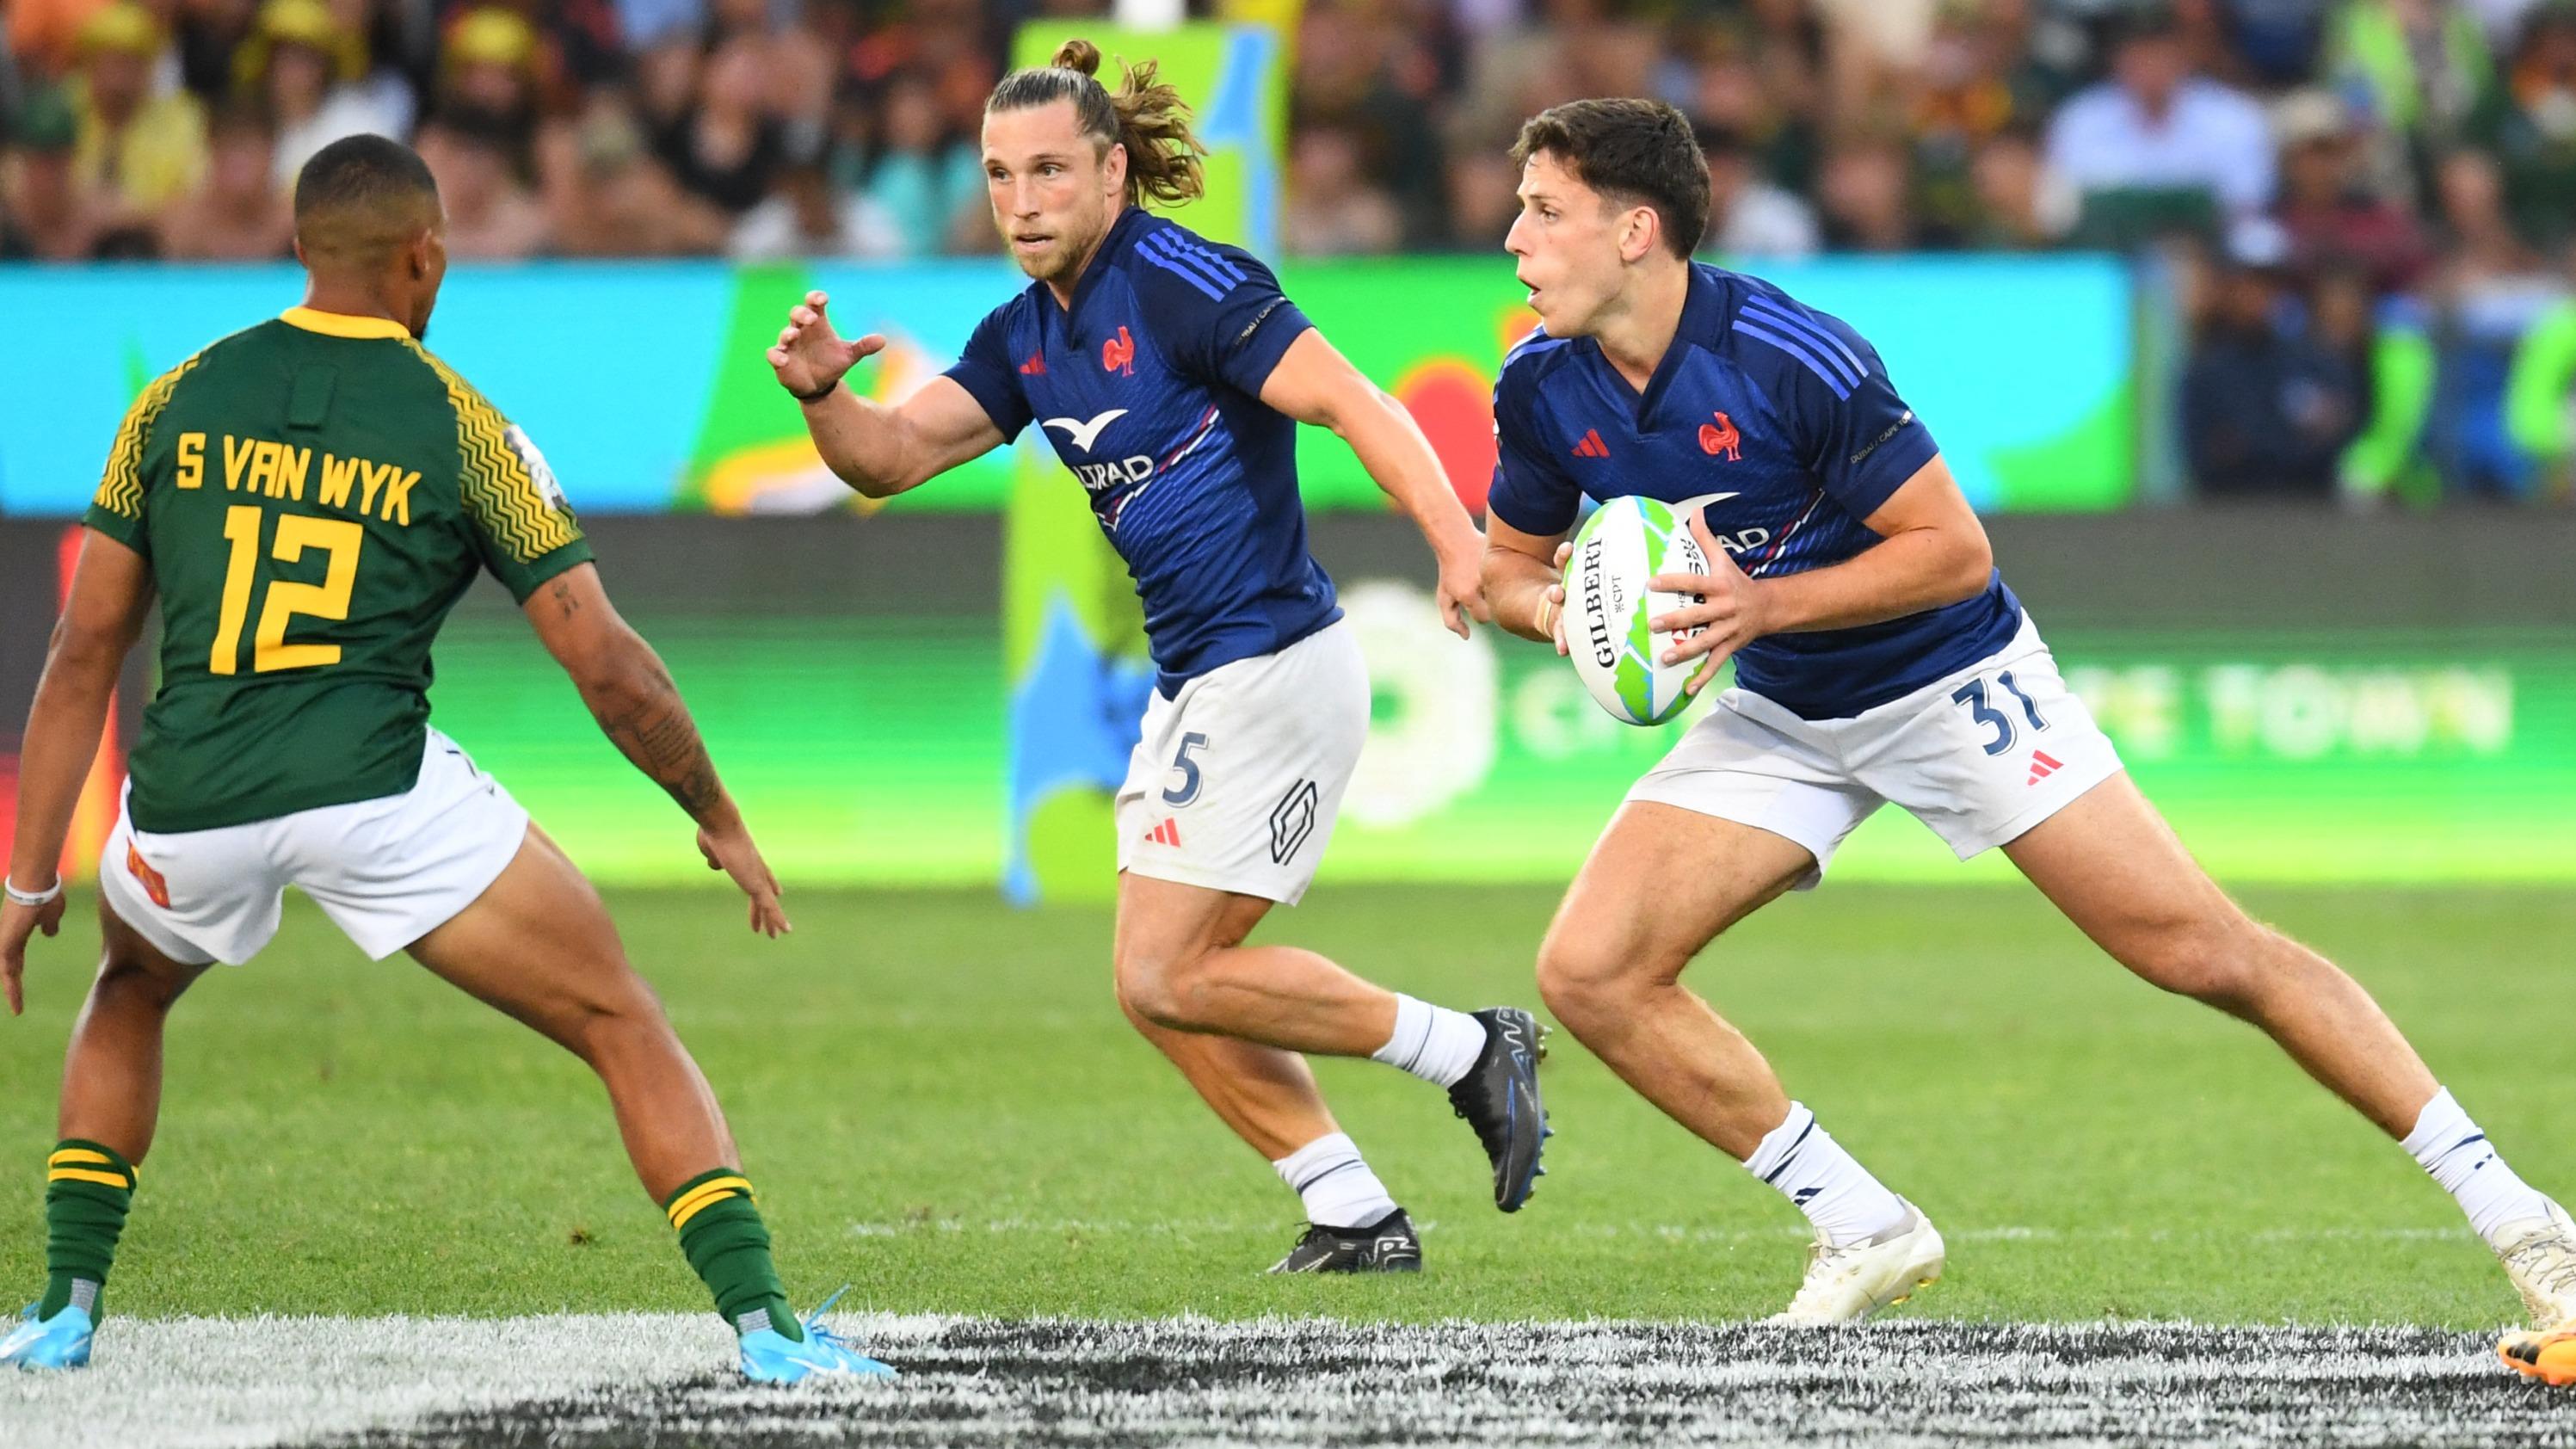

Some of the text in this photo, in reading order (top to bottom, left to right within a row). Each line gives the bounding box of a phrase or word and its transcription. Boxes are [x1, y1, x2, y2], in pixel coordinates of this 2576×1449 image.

[1073, 454, 1154, 490] LTRAD
[1879, 423, 1899, 442] CAPE
[176, 432, 422, 527] S VAN WYK
[209, 504, 363, 675] 12
[1584, 537, 1615, 669] GILBERT
[1612, 575, 1623, 603] CPT
[1950, 670, 2050, 756] 31
[1162, 731, 1209, 808] 5
